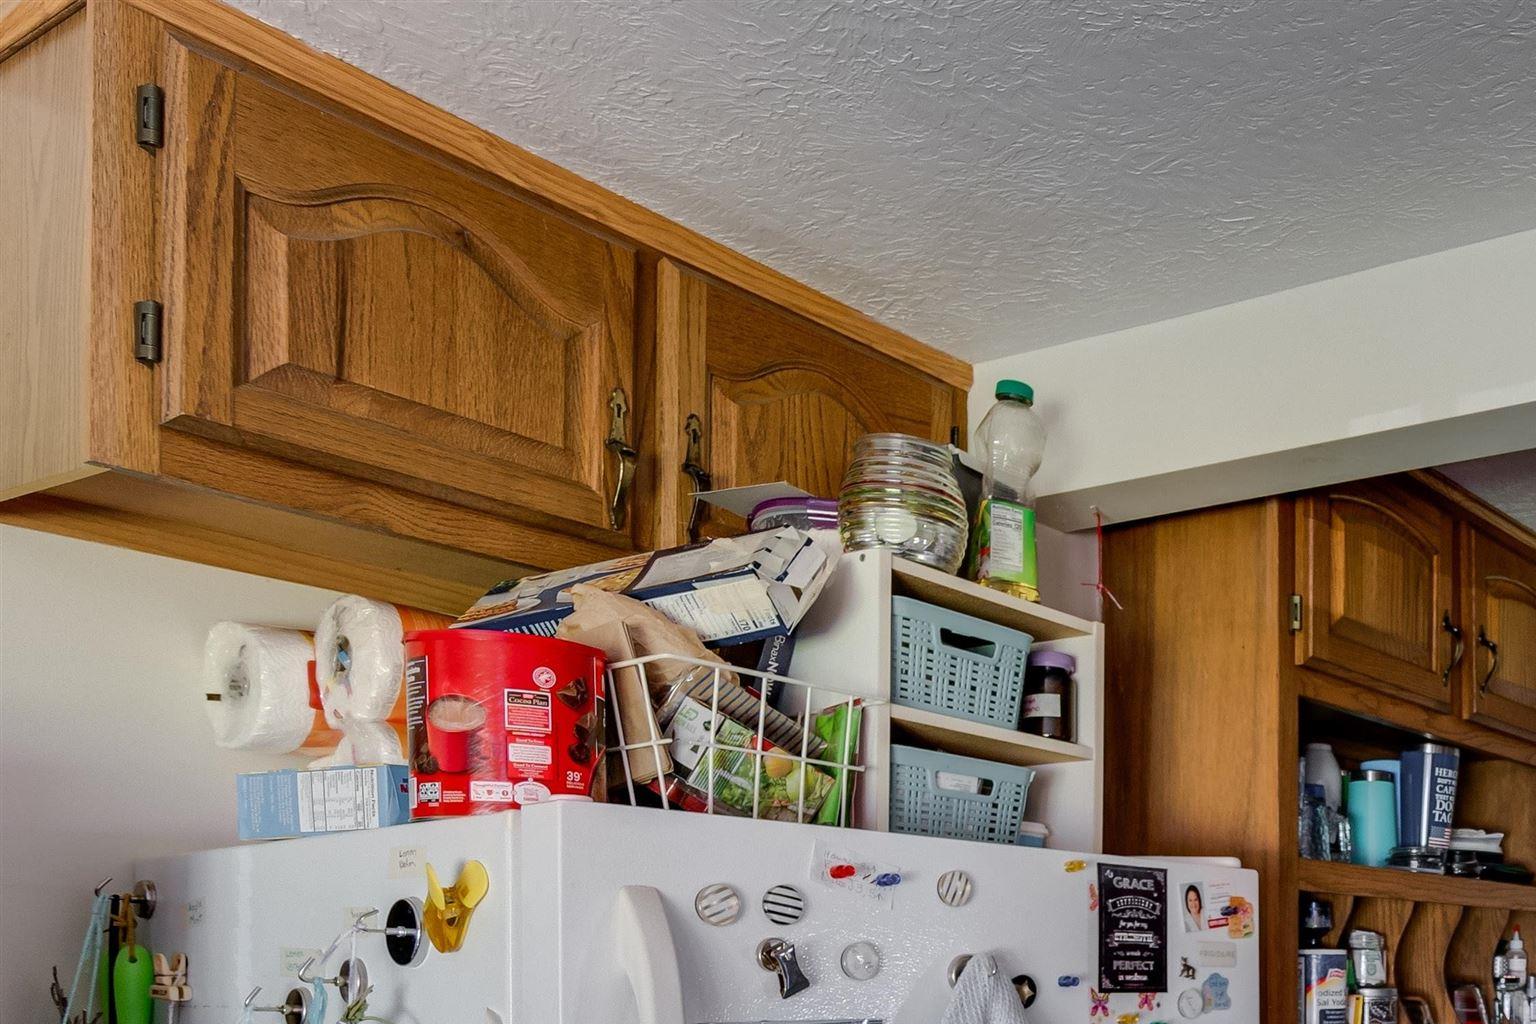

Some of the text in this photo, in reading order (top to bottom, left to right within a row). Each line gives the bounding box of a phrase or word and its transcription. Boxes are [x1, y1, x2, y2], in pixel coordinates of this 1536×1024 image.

[508, 696, 548, 706] Cocoa Plan
[1112, 876, 1155, 891] GRACE
[1113, 960, 1155, 971] PERFECT
